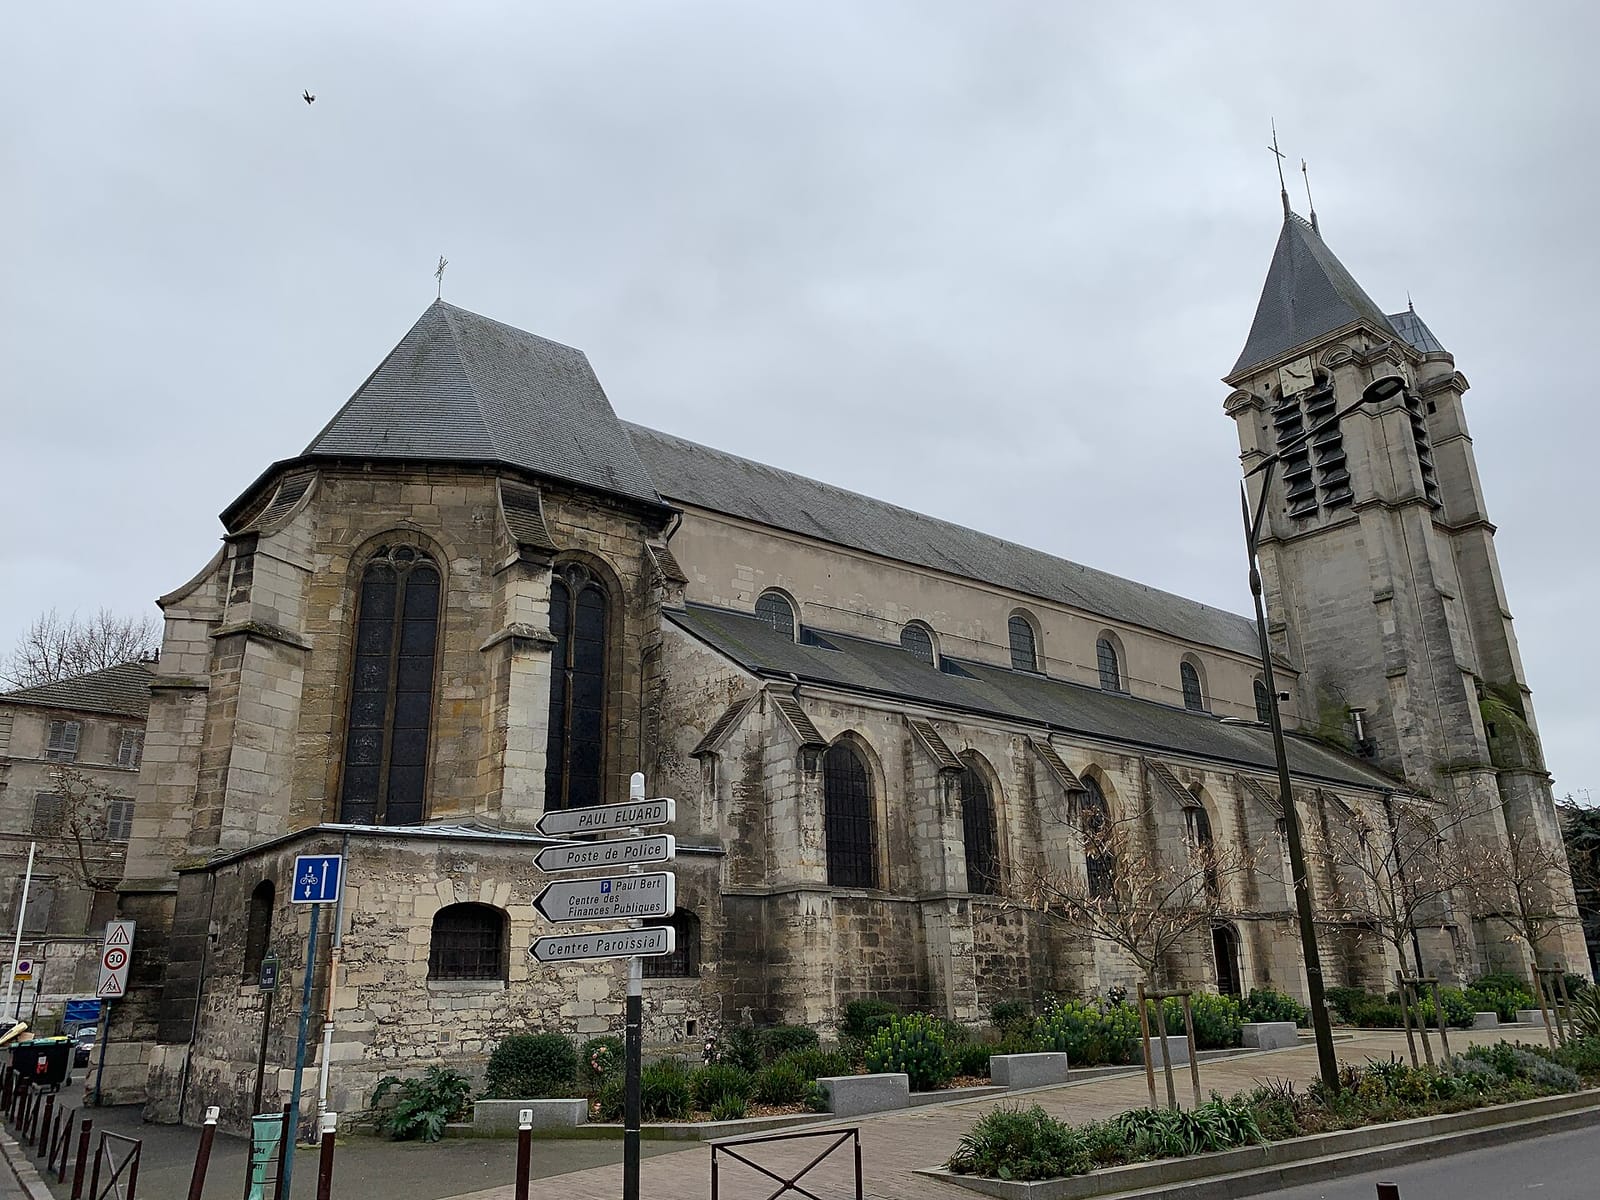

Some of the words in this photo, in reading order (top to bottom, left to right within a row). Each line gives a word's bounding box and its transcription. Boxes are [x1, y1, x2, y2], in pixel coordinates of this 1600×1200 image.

[579, 813, 607, 826] PAUL
[615, 806, 661, 822] ELUARD
[567, 852, 599, 863] Poste
[605, 848, 618, 860] de
[624, 844, 661, 858] Police
[616, 879, 636, 891] Paul
[640, 879, 660, 889] Bert
[568, 895, 599, 906] Centre
[603, 893, 620, 903] des
[568, 906, 610, 917] Finances
[613, 901, 660, 916] Publiques
[548, 943, 589, 955] Centre
[596, 935, 661, 952] Paroissial
[109, 954, 122, 963] 30
